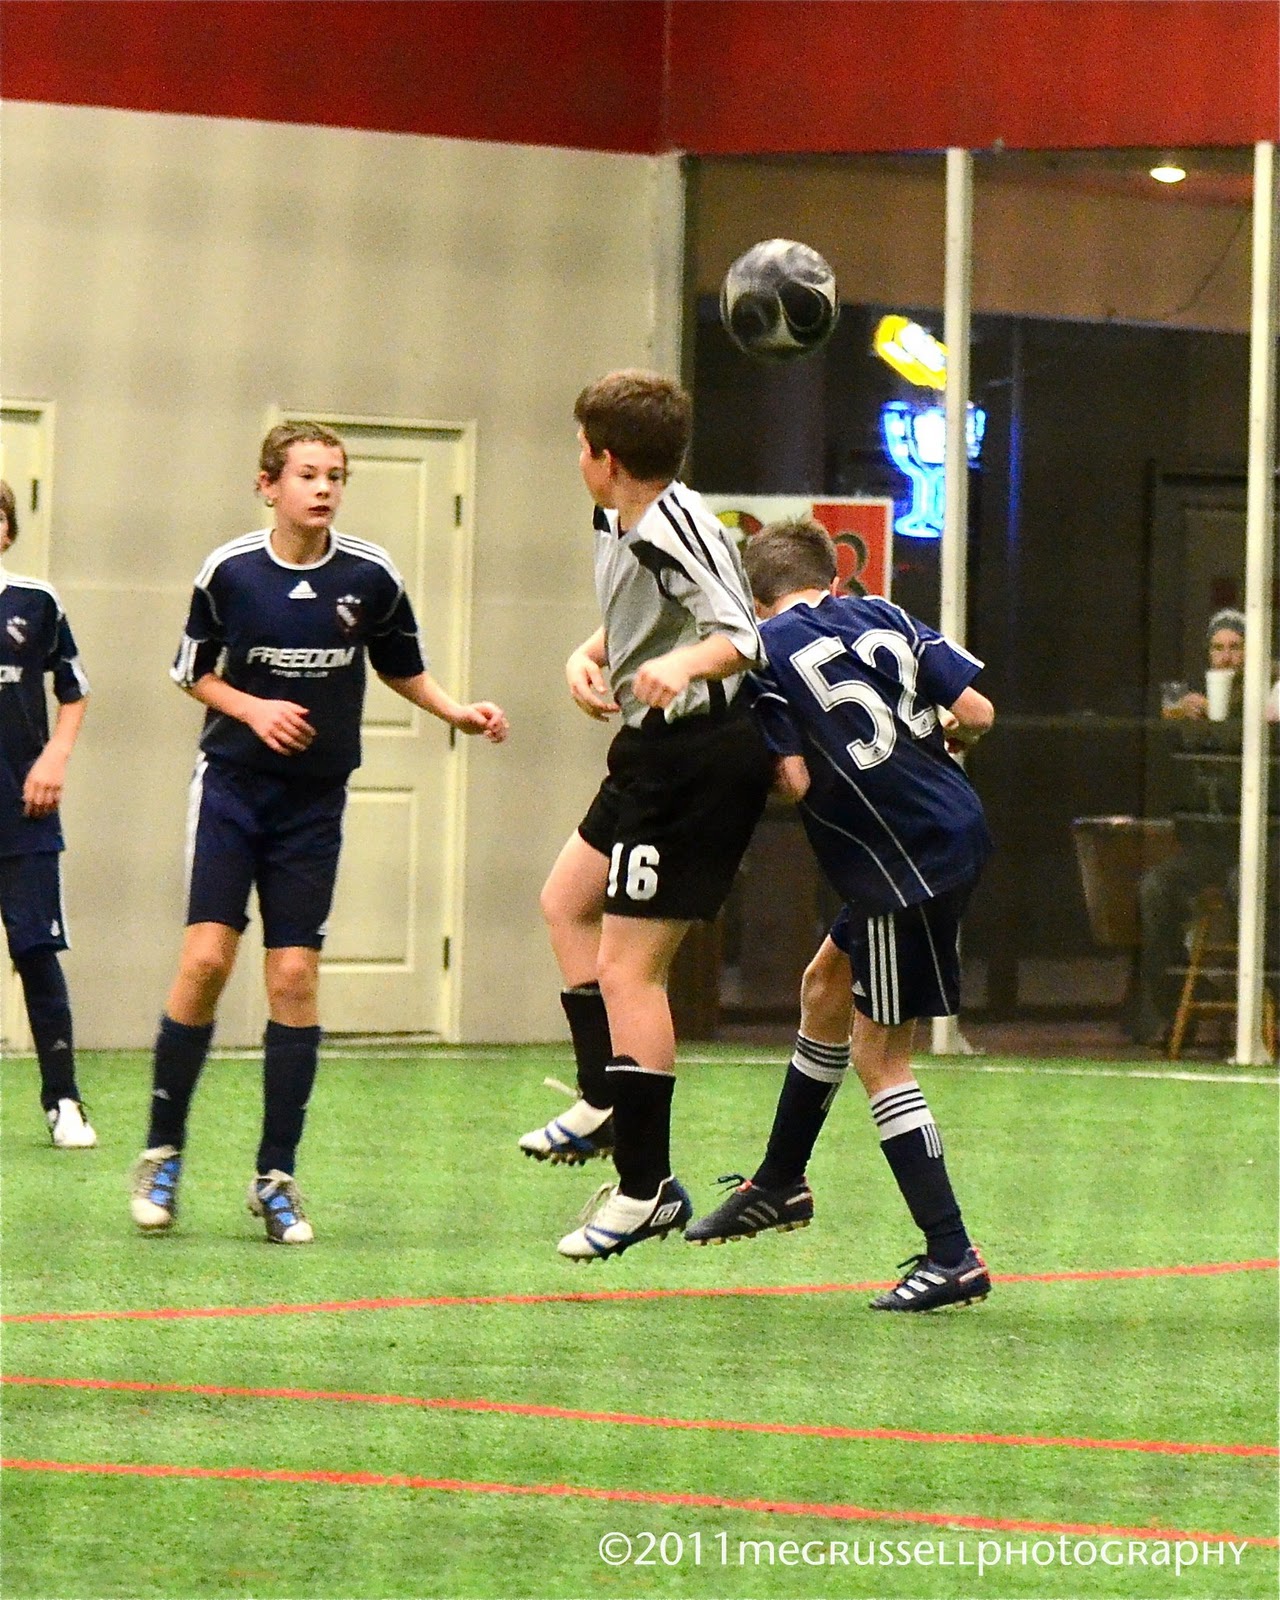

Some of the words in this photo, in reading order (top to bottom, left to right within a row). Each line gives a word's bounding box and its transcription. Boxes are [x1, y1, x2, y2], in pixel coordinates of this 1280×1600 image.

[246, 646, 356, 669] FREEDOM
[789, 629, 938, 770] 52
[606, 842, 660, 900] 16
